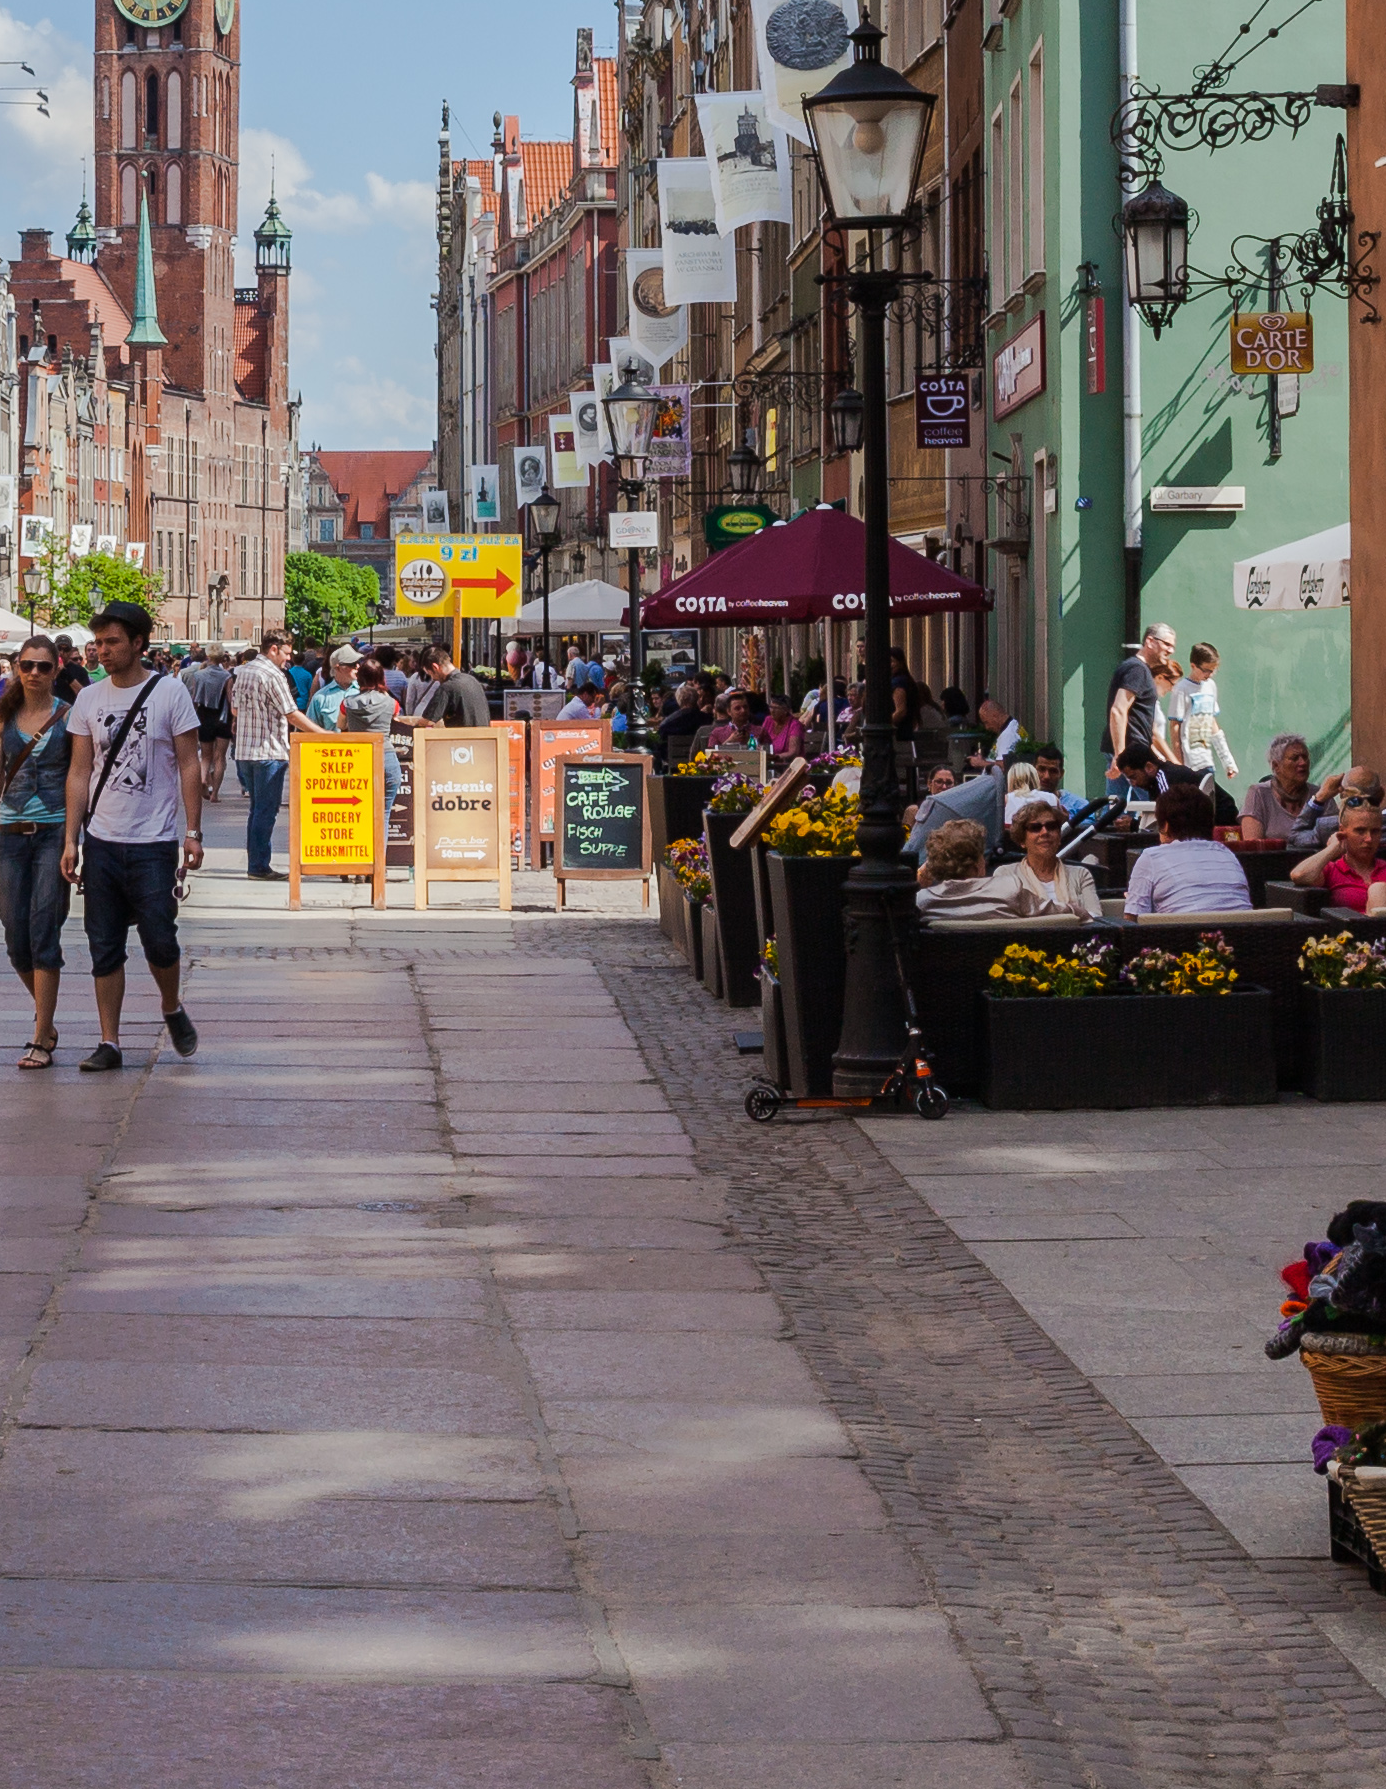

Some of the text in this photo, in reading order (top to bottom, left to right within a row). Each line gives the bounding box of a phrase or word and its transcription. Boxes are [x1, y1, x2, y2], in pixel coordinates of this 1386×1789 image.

[1236, 328, 1308, 351] CARTE
[1246, 348, 1304, 371] D'OR
[920, 378, 965, 393] COSTA
[924, 427, 962, 436] coffee
[1167, 490, 1203, 502] Garbary
[504, 535, 519, 545] ZA
[441, 545, 453, 561] 9
[676, 597, 727, 614] COSTA
[321, 762, 354, 773] SKLEP
[305, 775, 369, 790] SPOŻYWCZY
[430, 780, 493, 796] jedzenie
[431, 795, 492, 811] dobre
[566, 791, 609, 807] CAFE
[312, 811, 361, 823] GROCERY
[583, 805, 636, 820] ROUGE
[320, 828, 354, 840] STORE
[567, 823, 603, 839] FISCH
[305, 845, 369, 857] LEBENSMITTEL
[579, 841, 628, 857] SUPPE
